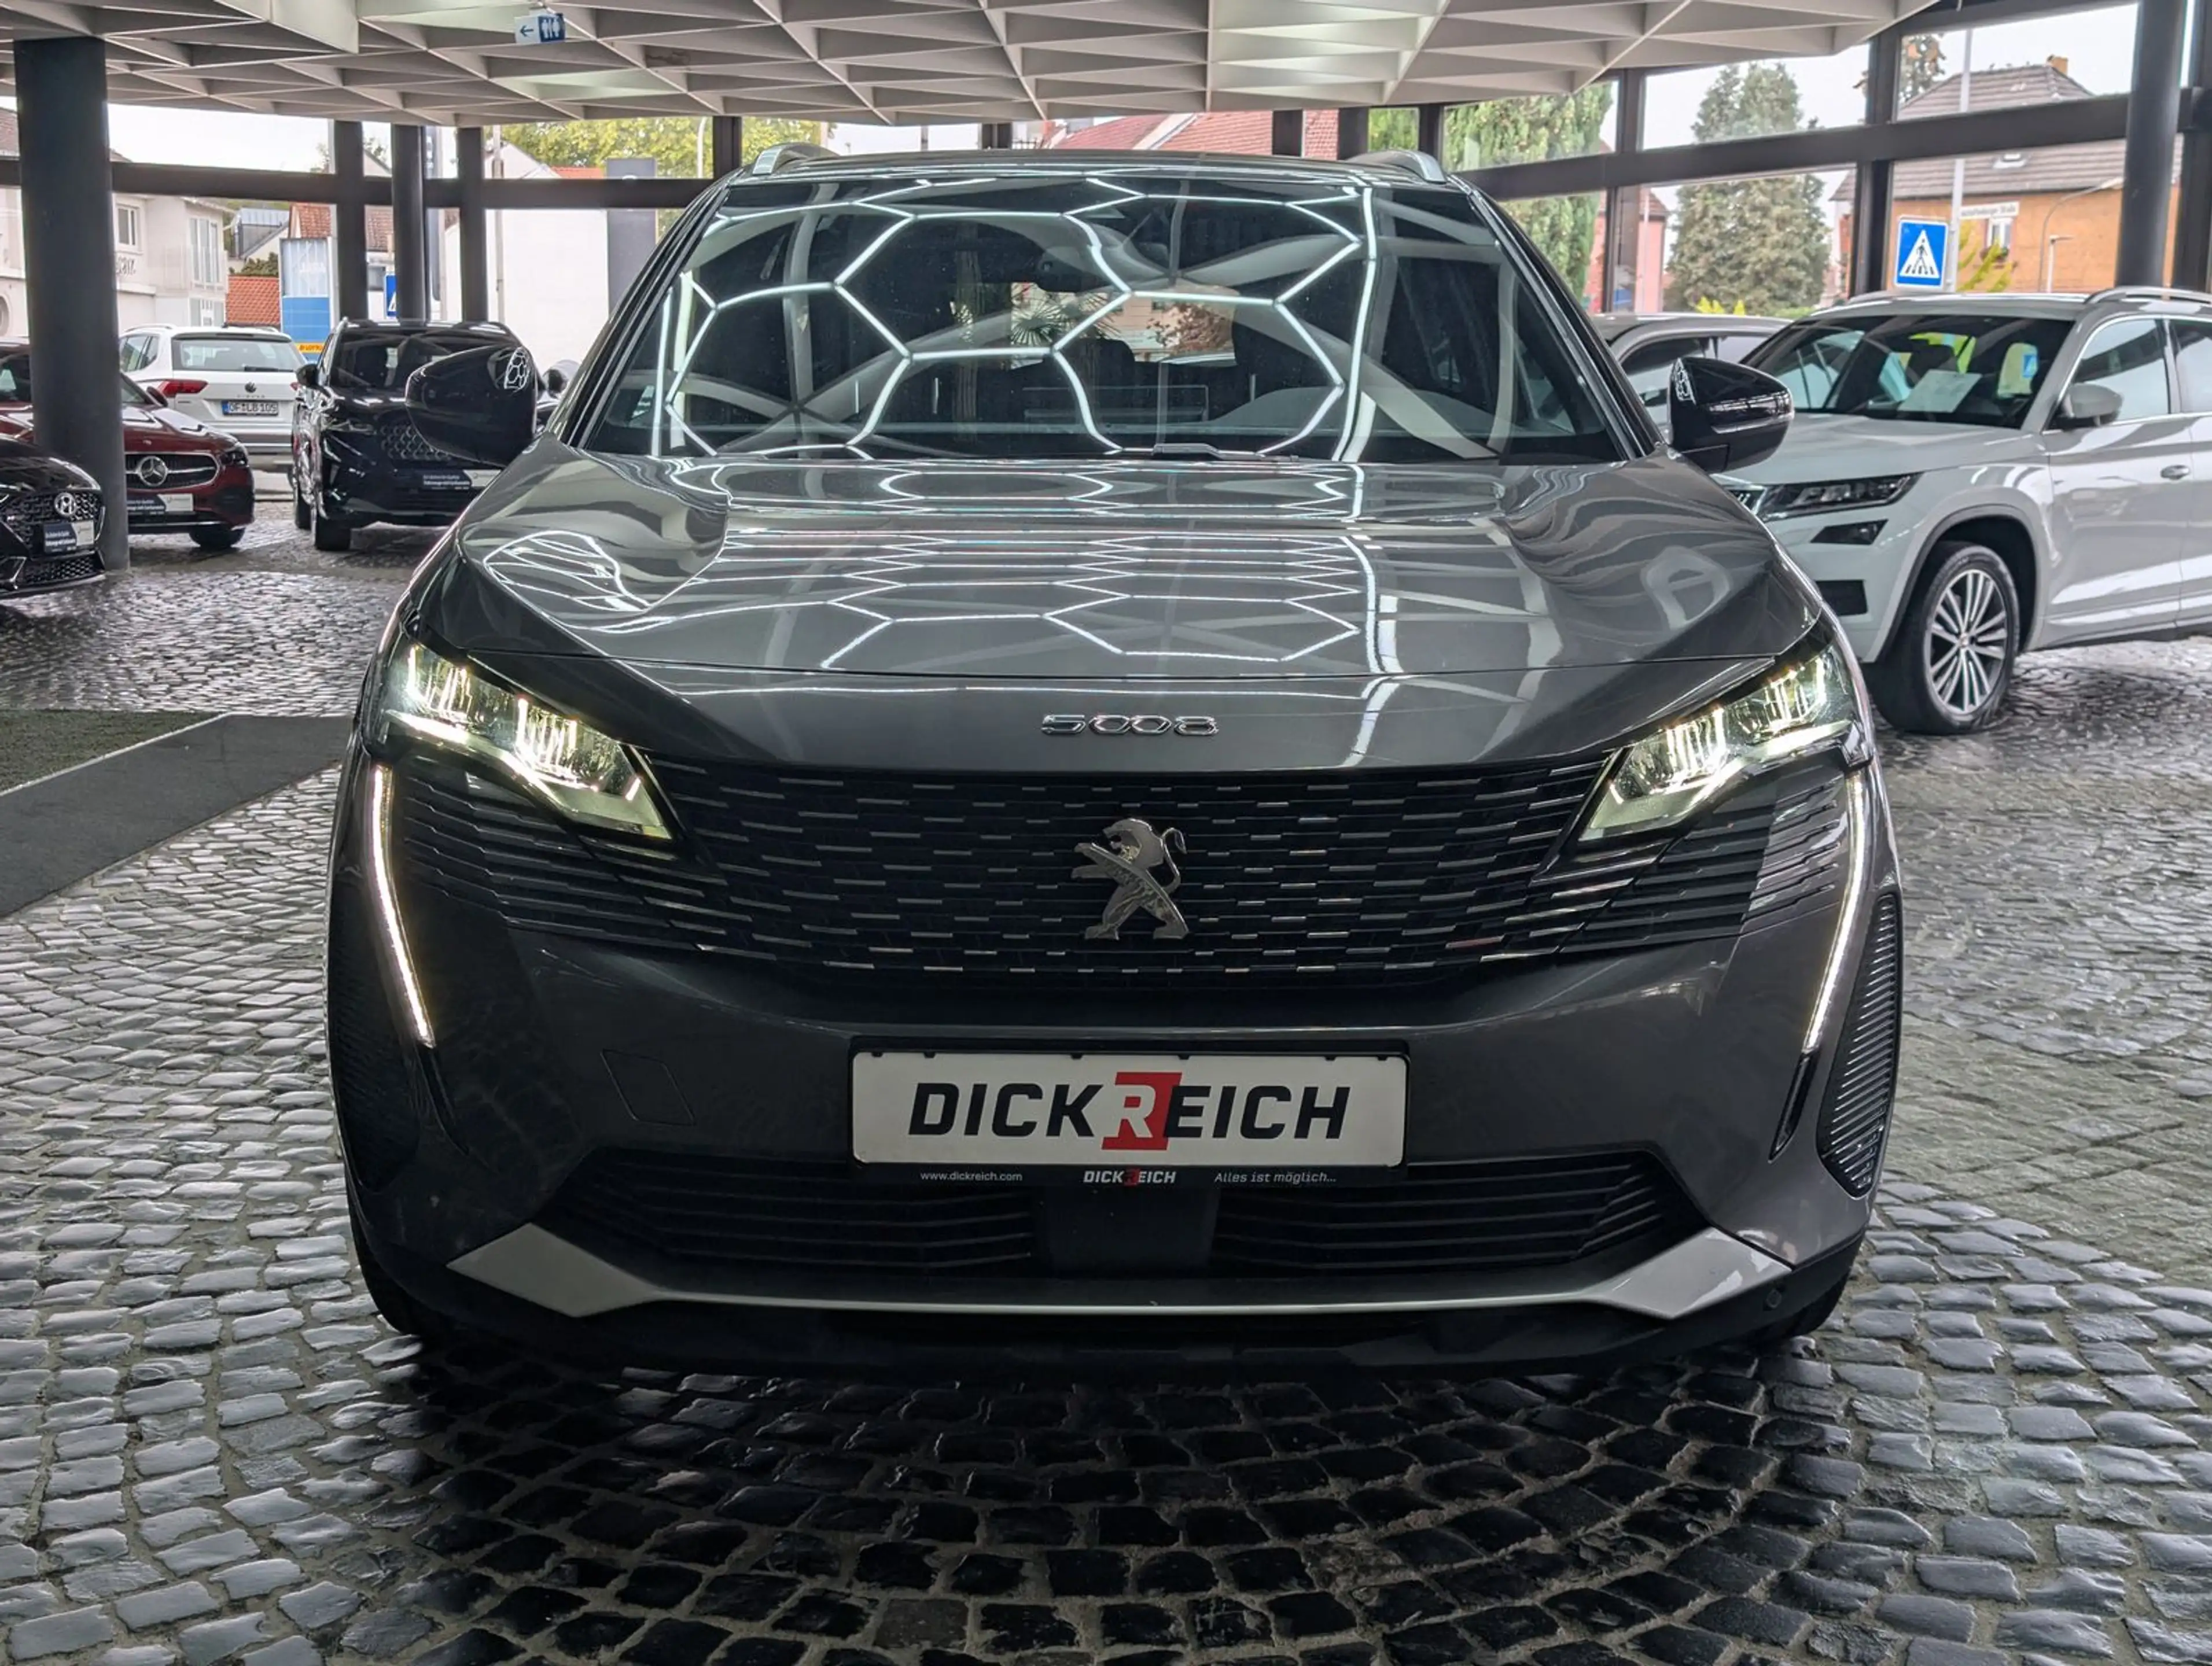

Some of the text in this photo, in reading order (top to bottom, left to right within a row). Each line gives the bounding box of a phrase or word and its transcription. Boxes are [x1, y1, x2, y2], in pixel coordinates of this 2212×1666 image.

[1041, 714, 1219, 736] 5008
[908, 1081, 1350, 1141] DICKREICH
[920, 1171, 1023, 1181] www.dickreich.com
[1214, 1171, 1337, 1185] Alles ist möglich...
